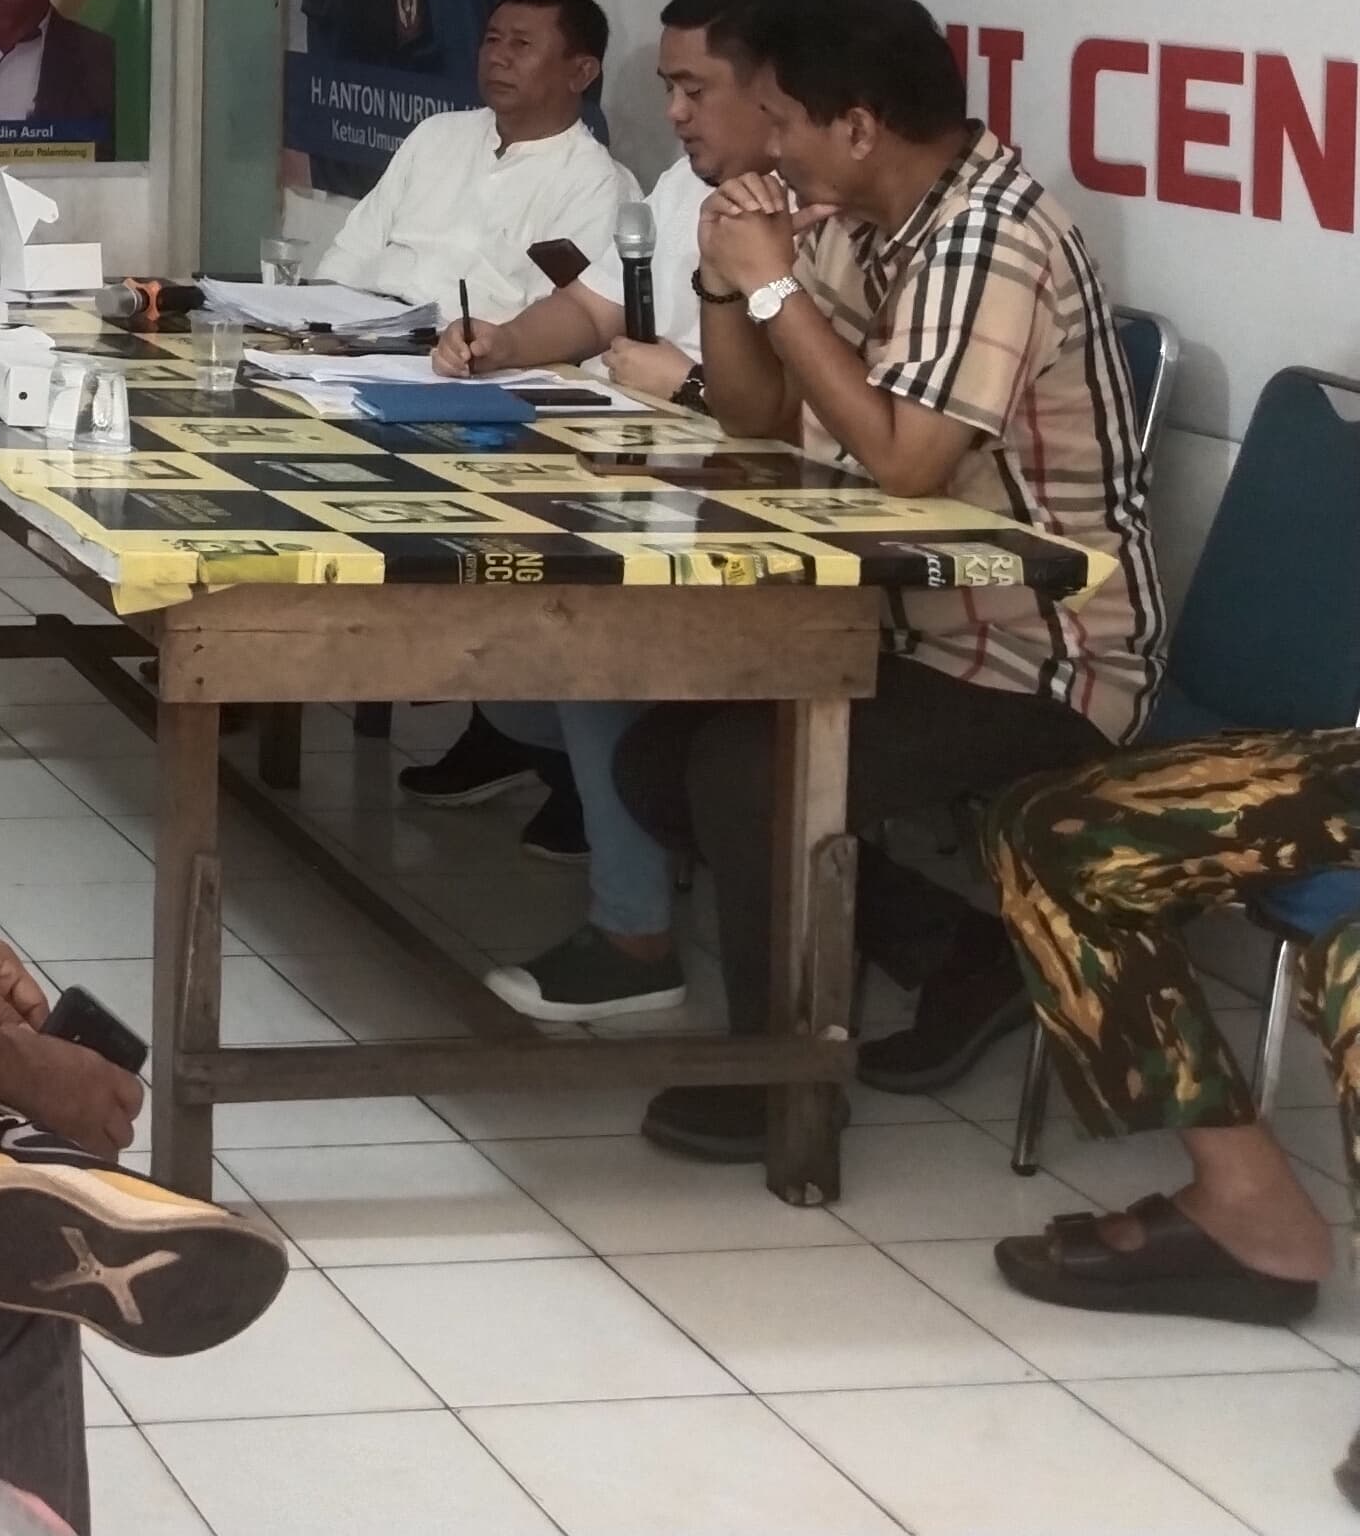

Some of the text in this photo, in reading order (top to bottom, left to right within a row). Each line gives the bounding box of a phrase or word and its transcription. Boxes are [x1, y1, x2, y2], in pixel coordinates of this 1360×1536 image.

[312, 76, 326, 105] H.
[328, 80, 385, 117] ANTON
[20, 125, 54, 138] Asral
[332, 118, 366, 144] Ketua
[37, 147, 88, 158] Palembang
